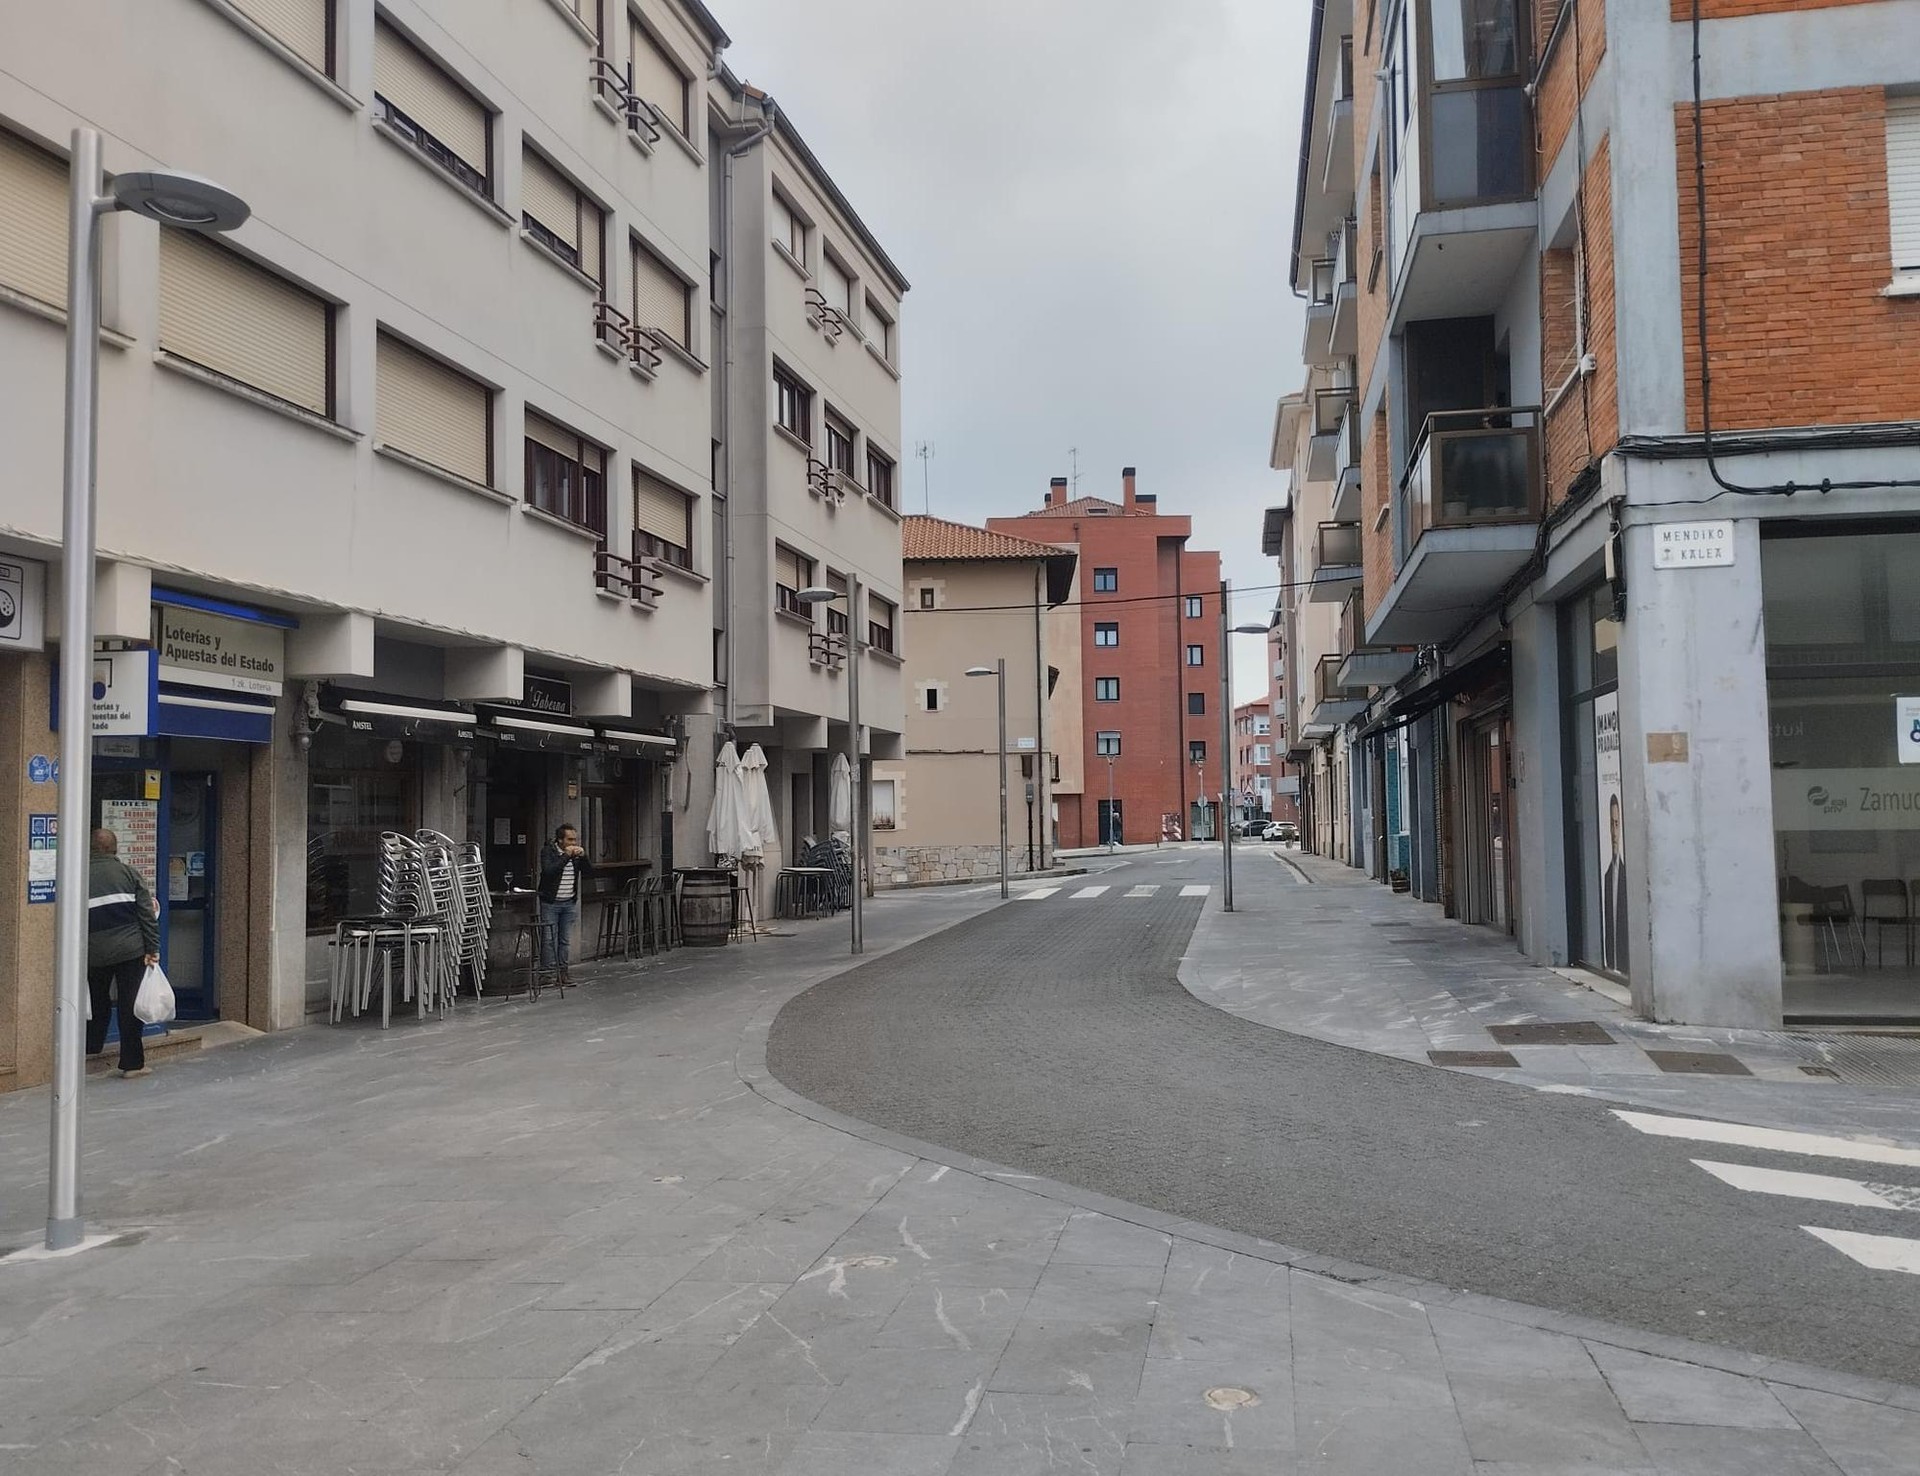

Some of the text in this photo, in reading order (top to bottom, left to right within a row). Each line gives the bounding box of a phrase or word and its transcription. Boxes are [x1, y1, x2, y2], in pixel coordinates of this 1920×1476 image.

[1663, 529, 1723, 541] MENDIKO
[1681, 548, 1721, 560] KALEA
[165, 625, 221, 651] Loterías y
[165, 643, 274, 672] Apuestas del Estado
[92, 722, 109, 730] tado
[352, 720, 373, 730] AMSTEL
[1597, 711, 1618, 735] IMANO
[457, 730, 474, 739] AMSTEL
[1598, 733, 1619, 753] PRADALE
